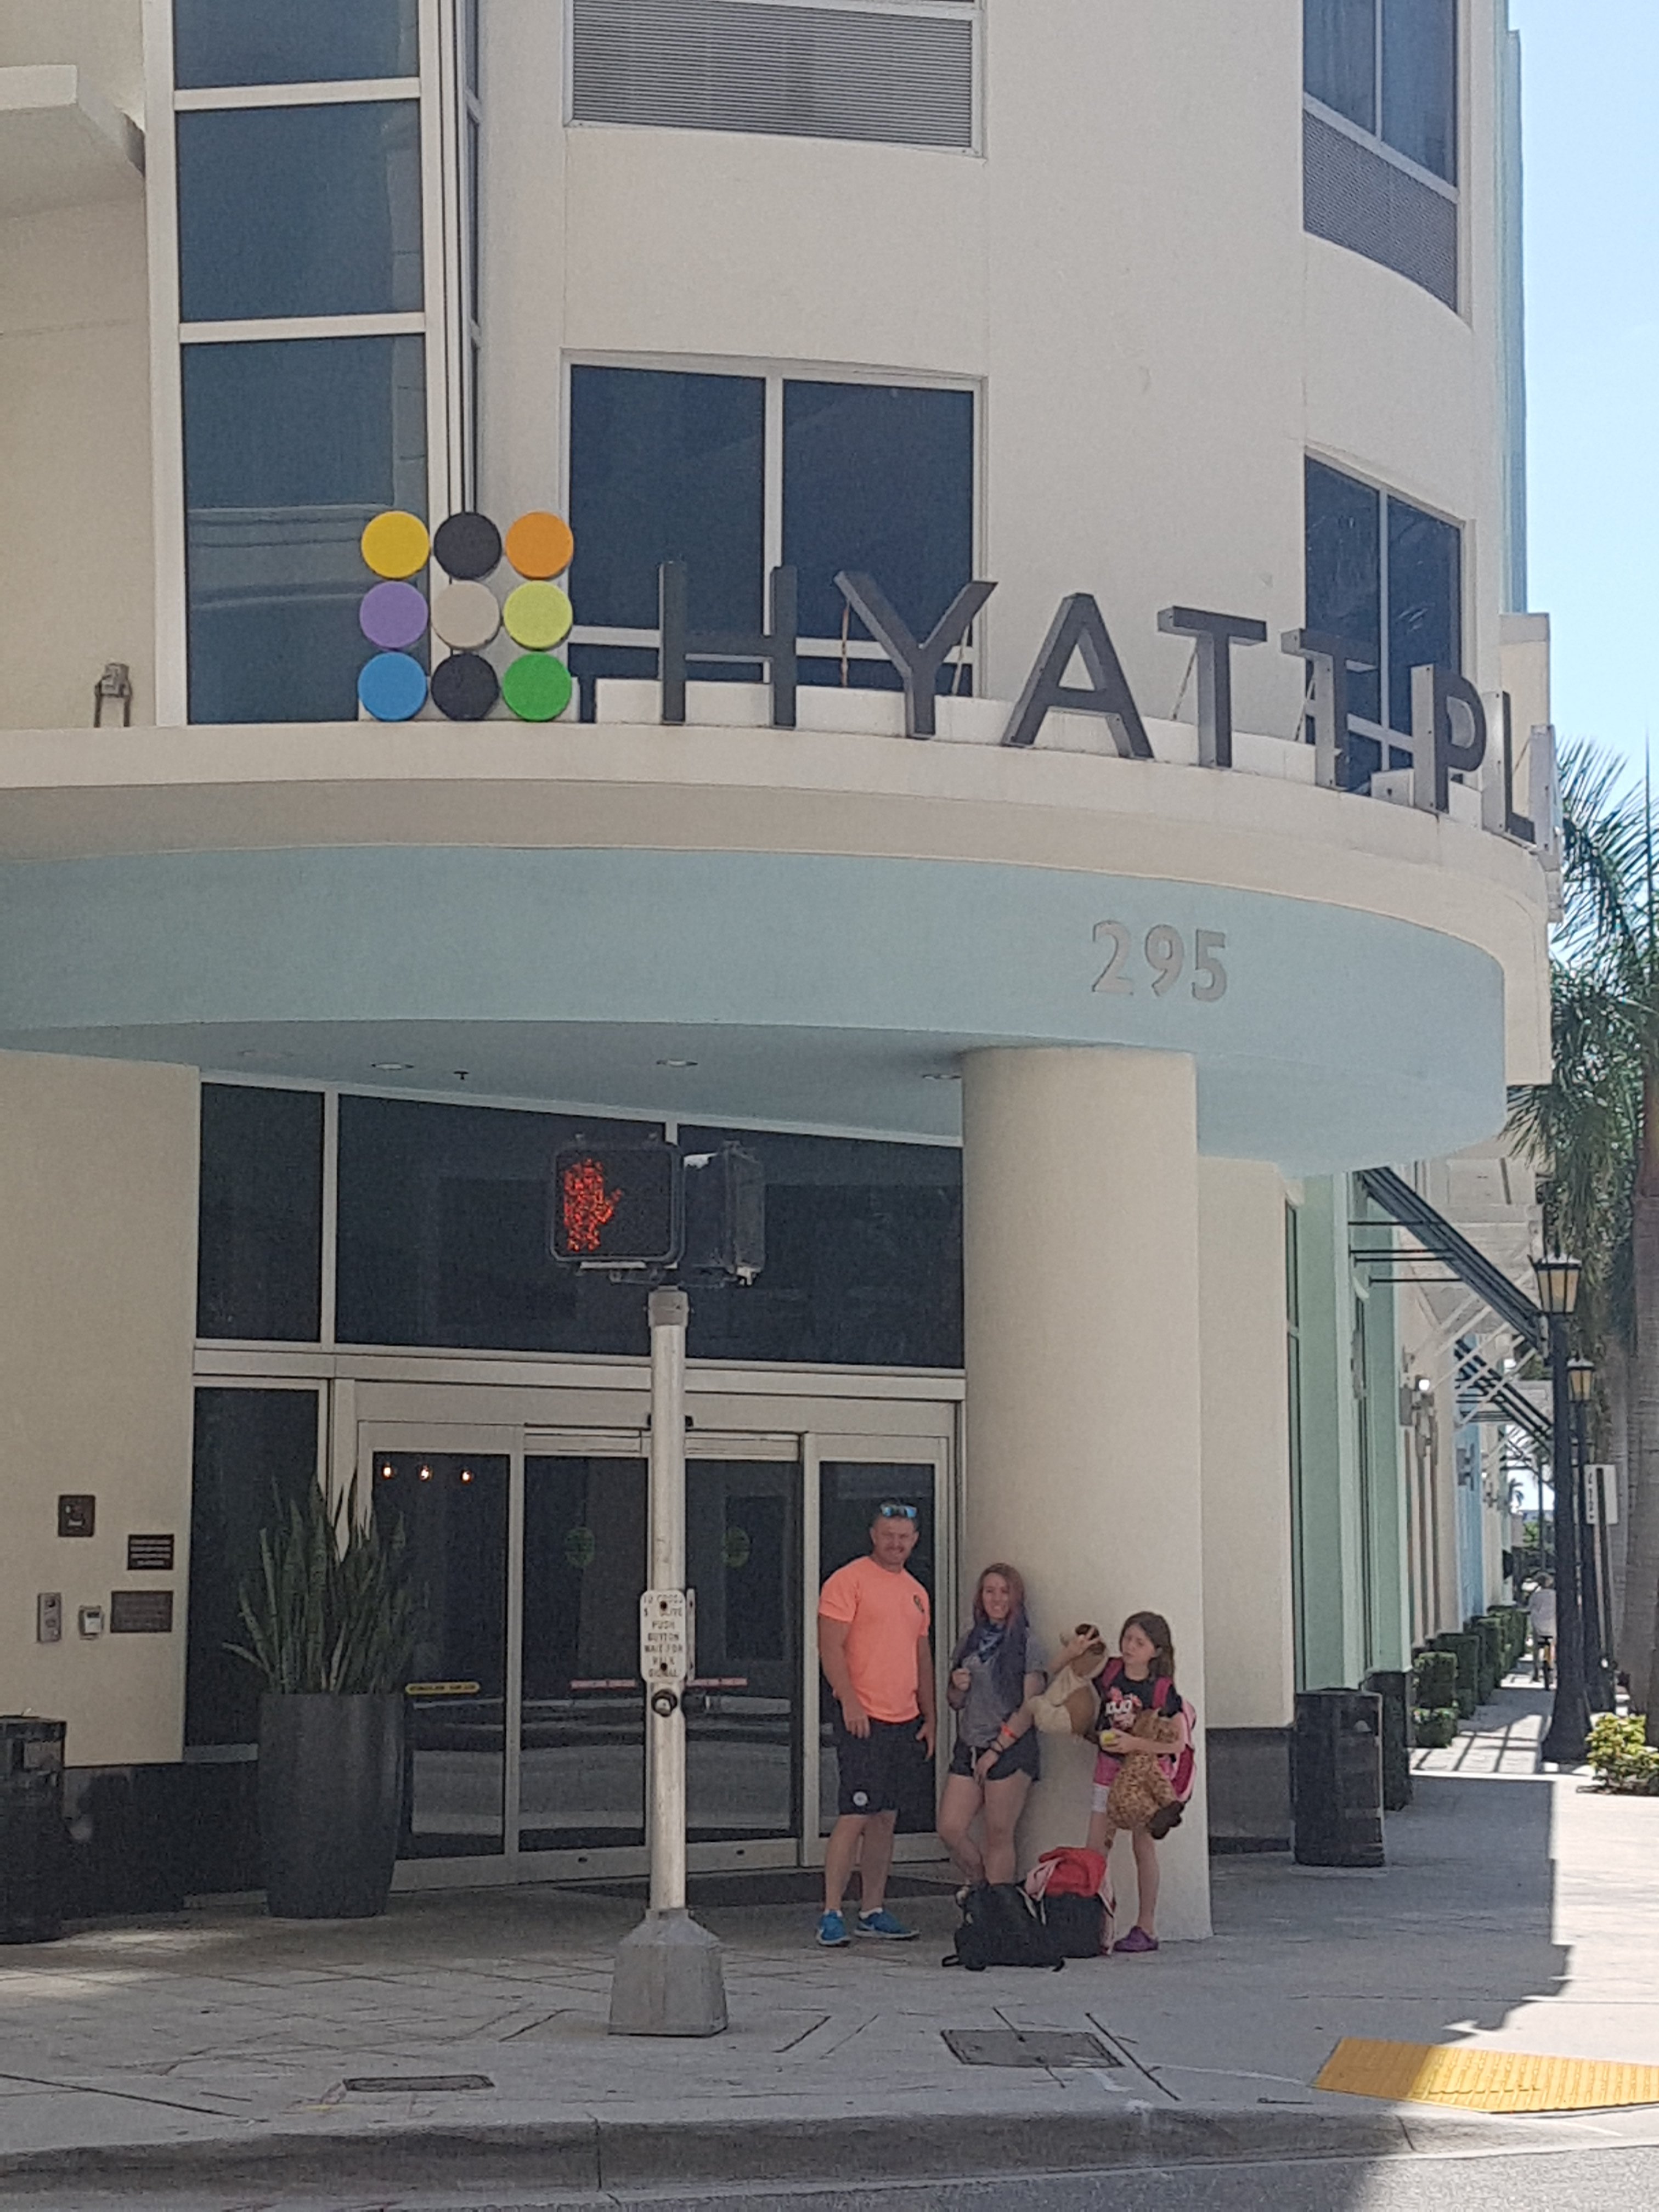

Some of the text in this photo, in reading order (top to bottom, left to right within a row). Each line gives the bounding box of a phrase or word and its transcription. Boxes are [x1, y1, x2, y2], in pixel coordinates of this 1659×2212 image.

[658, 561, 1379, 792] HYATT
[1092, 919, 1228, 1002] 295
[648, 1633, 679, 1642] BUTTON
[652, 1620, 675, 1630] PUSH
